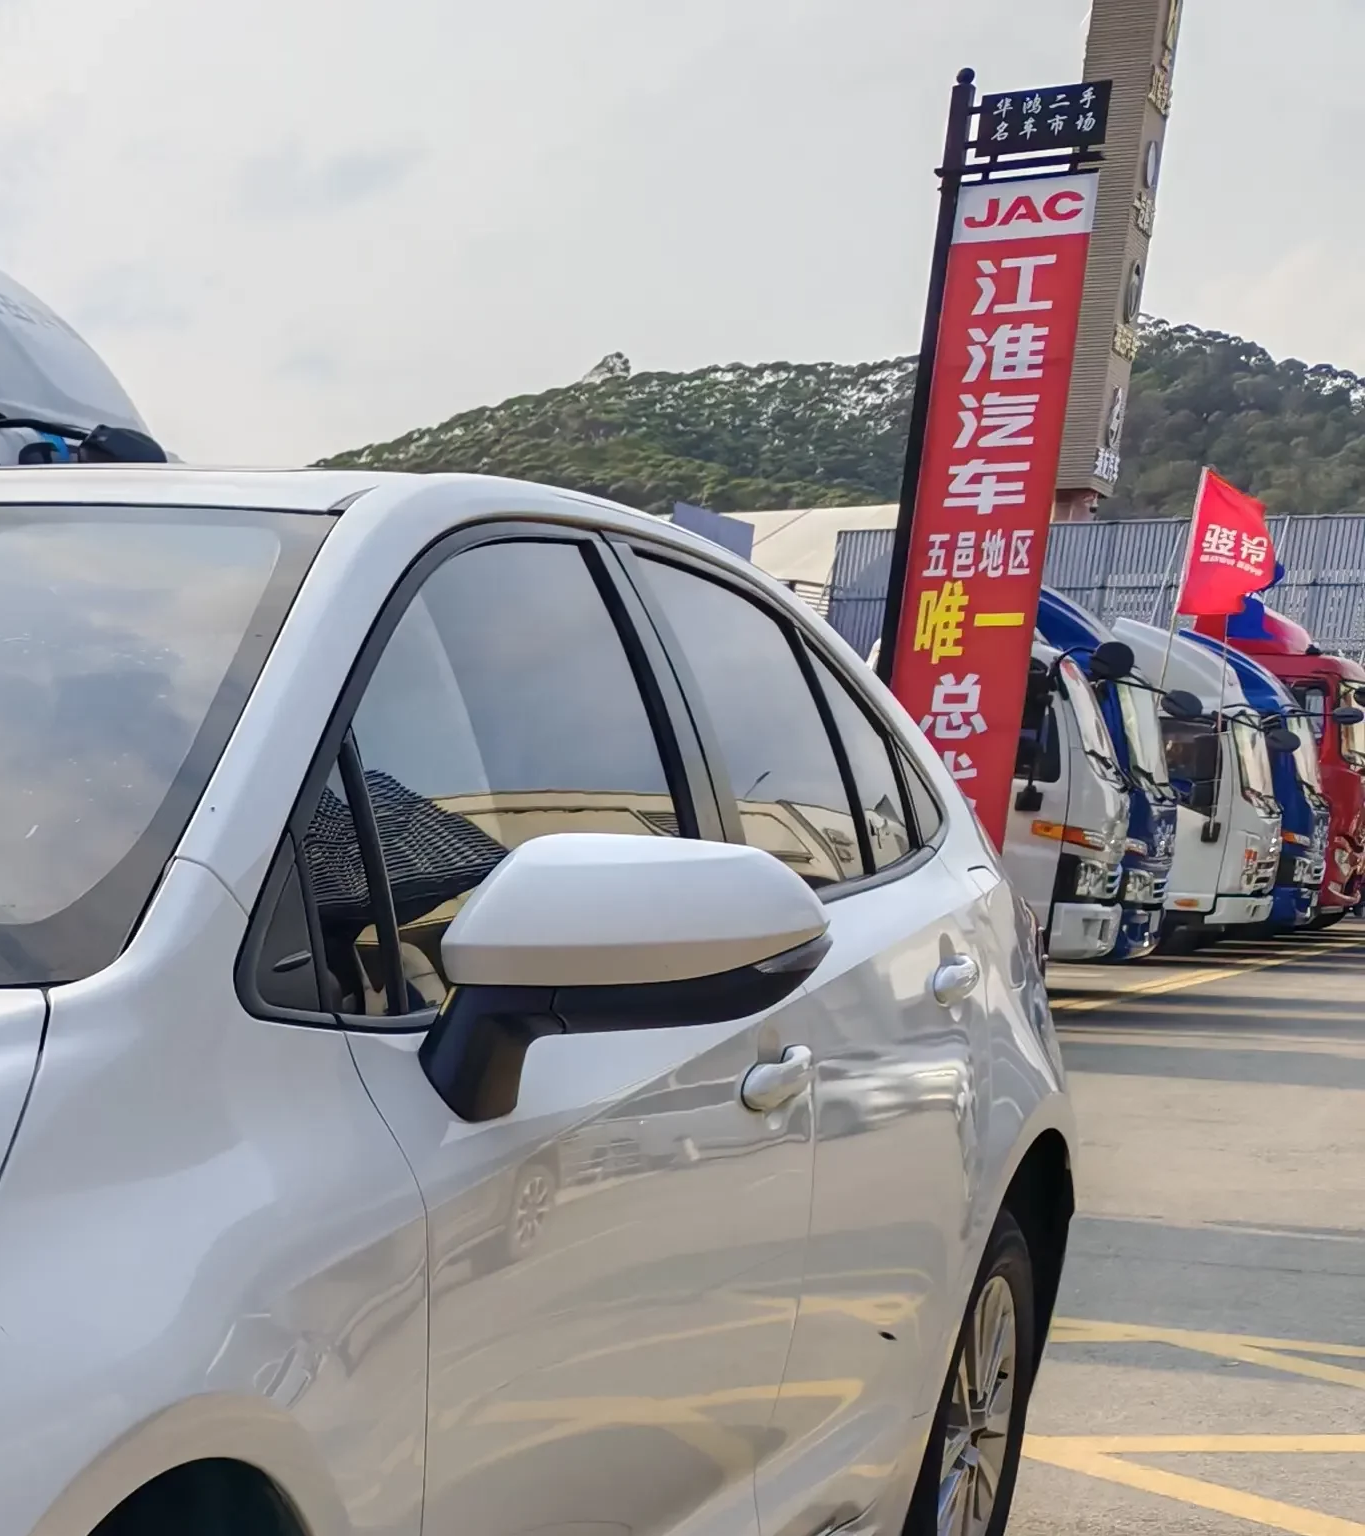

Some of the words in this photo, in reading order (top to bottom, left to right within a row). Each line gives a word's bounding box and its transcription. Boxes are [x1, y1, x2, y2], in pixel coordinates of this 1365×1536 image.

[993, 87, 1097, 119] 华鸿二手
[990, 112, 1097, 141] 名车市场
[963, 190, 1086, 229] JAC
[942, 254, 1058, 515] 江淮汽车
[922, 529, 1035, 579] 五邑地区
[913, 580, 1026, 665] 唯一
